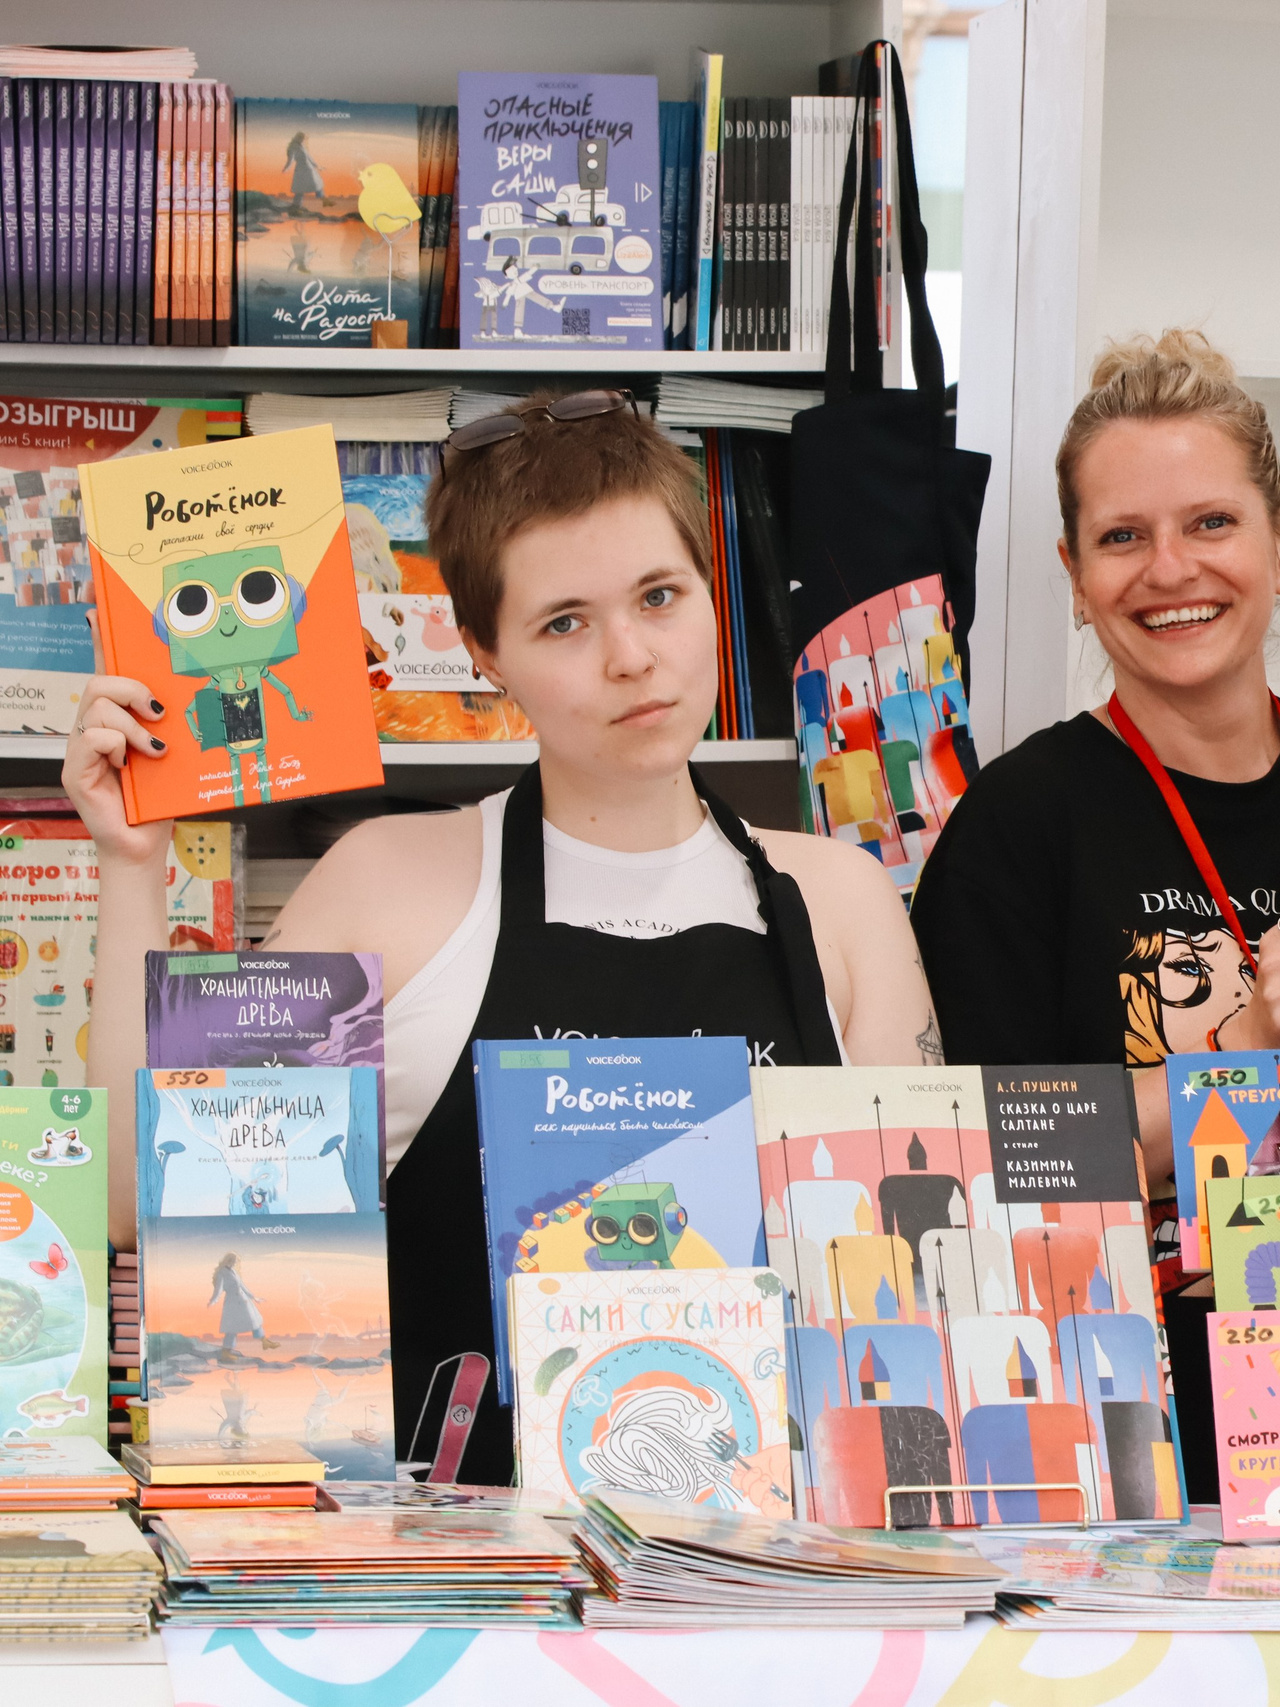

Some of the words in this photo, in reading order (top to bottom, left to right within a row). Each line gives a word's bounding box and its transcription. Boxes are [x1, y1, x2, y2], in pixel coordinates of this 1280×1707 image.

[484, 93, 593, 119] ОПАСНЫЕ
[483, 118, 633, 146] ПРИКЛЮЧЕНИЯ
[496, 143, 552, 171] ВЕРЫ
[491, 172, 557, 198] САШИ
[5, 211, 18, 238] ДРЕВА
[58, 212, 69, 239] ДРЕВА
[106, 213, 118, 240] ДРЕВА
[140, 215, 151, 241] ДРЕВА
[301, 279, 381, 306] Охота
[543, 280, 588, 289] УРОВЕНЬ
[591, 281, 649, 290] ТРАНСПОРТ
[272, 308, 296, 324] на
[22, 433, 30, 446] 5
[35, 436, 71, 448] книг!
[215, 523, 236, 537] своё
[394, 662, 469, 676] VOICEBOOK
[11, 892, 70, 905] первый
[30, 914, 70, 923] нажми
[200, 976, 332, 1000] ХРАНИТЕЛЬНИЦА
[236, 1003, 293, 1026] ДРЕВА
[167, 1071, 208, 1085] 550
[1199, 1069, 1247, 1088] 250
[61, 1094, 81, 1105] 4-6
[191, 1095, 325, 1119] ХРАНИТЕЛЬНИЦА
[63, 1104, 79, 1114] лет
[999, 1102, 1047, 1115] СКАЗКА
[1052, 1102, 1061, 1114] О
[1066, 1102, 1098, 1116] ЦАРЕ
[1001, 1119, 1056, 1131] САЛТАНЕ
[229, 1124, 286, 1148] ДРЕВА
[1006, 1160, 1074, 1172] КАЗИМИРА
[1008, 1176, 1077, 1189] МАЛЕВИЧА
[545, 1304, 625, 1333] САМИ
[640, 1302, 651, 1331] С
[666, 1300, 763, 1330] УСАМИ
[1226, 1327, 1273, 1345] 250
